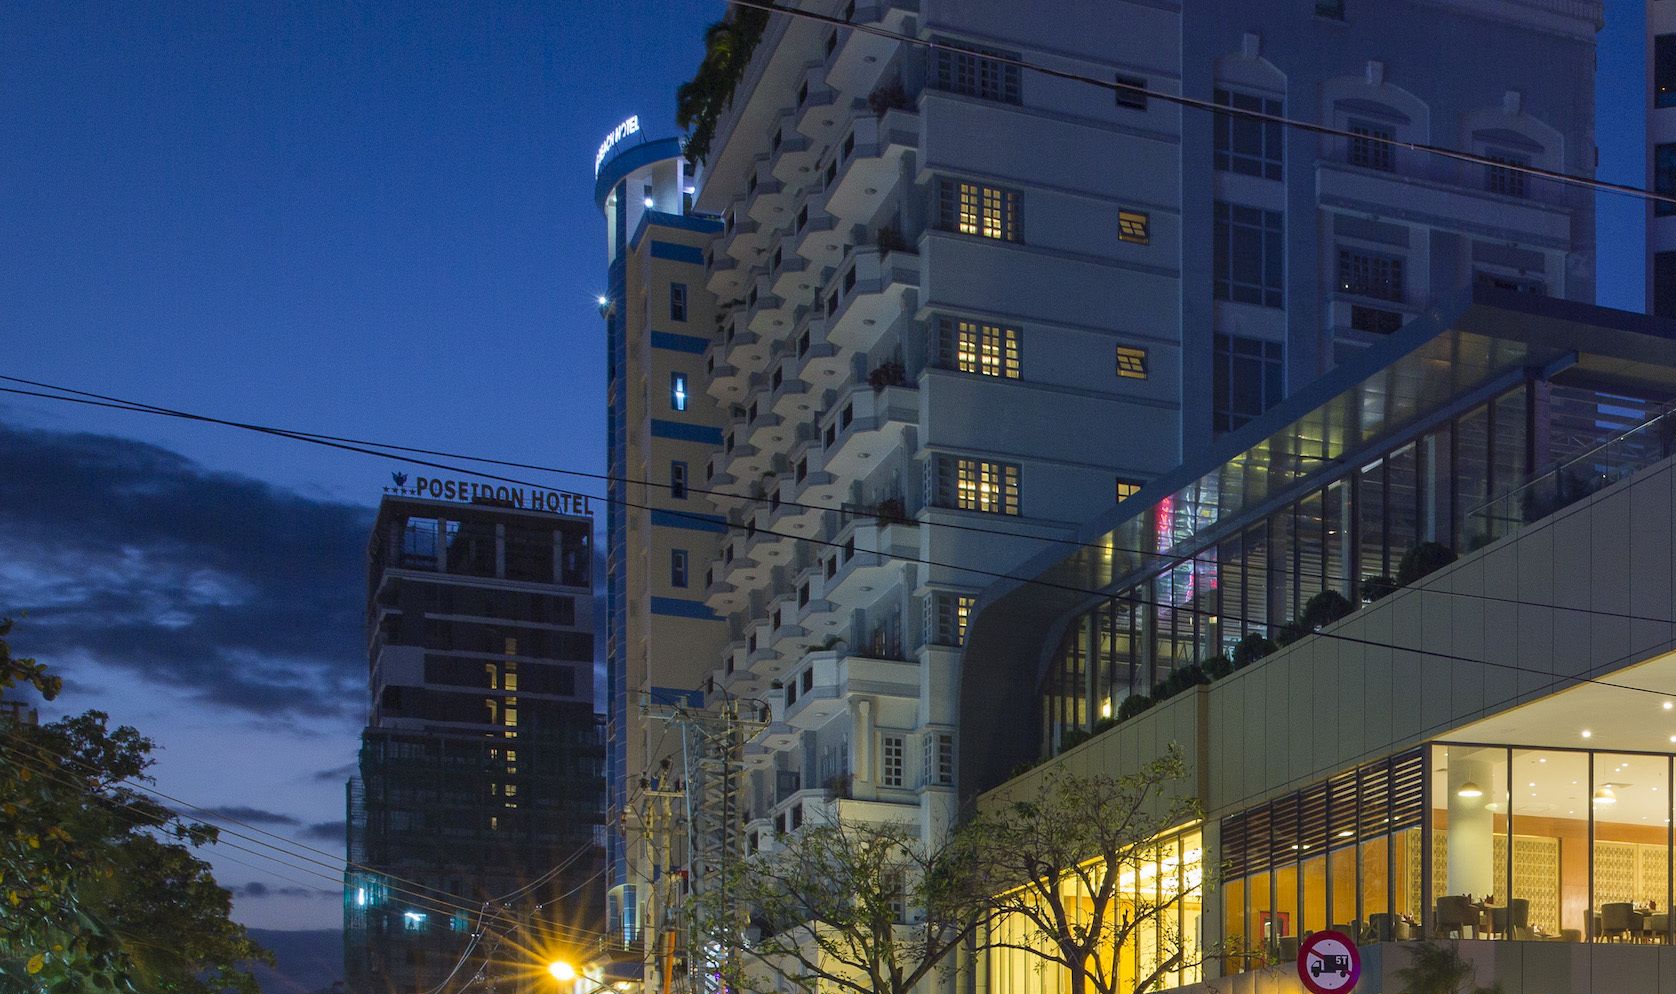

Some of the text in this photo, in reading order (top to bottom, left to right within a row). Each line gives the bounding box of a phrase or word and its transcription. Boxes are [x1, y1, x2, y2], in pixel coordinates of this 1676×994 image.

[615, 115, 640, 143] HOTEL
[417, 476, 594, 516] POSEIDON HOTEL
[1335, 955, 1348, 965] 5T
